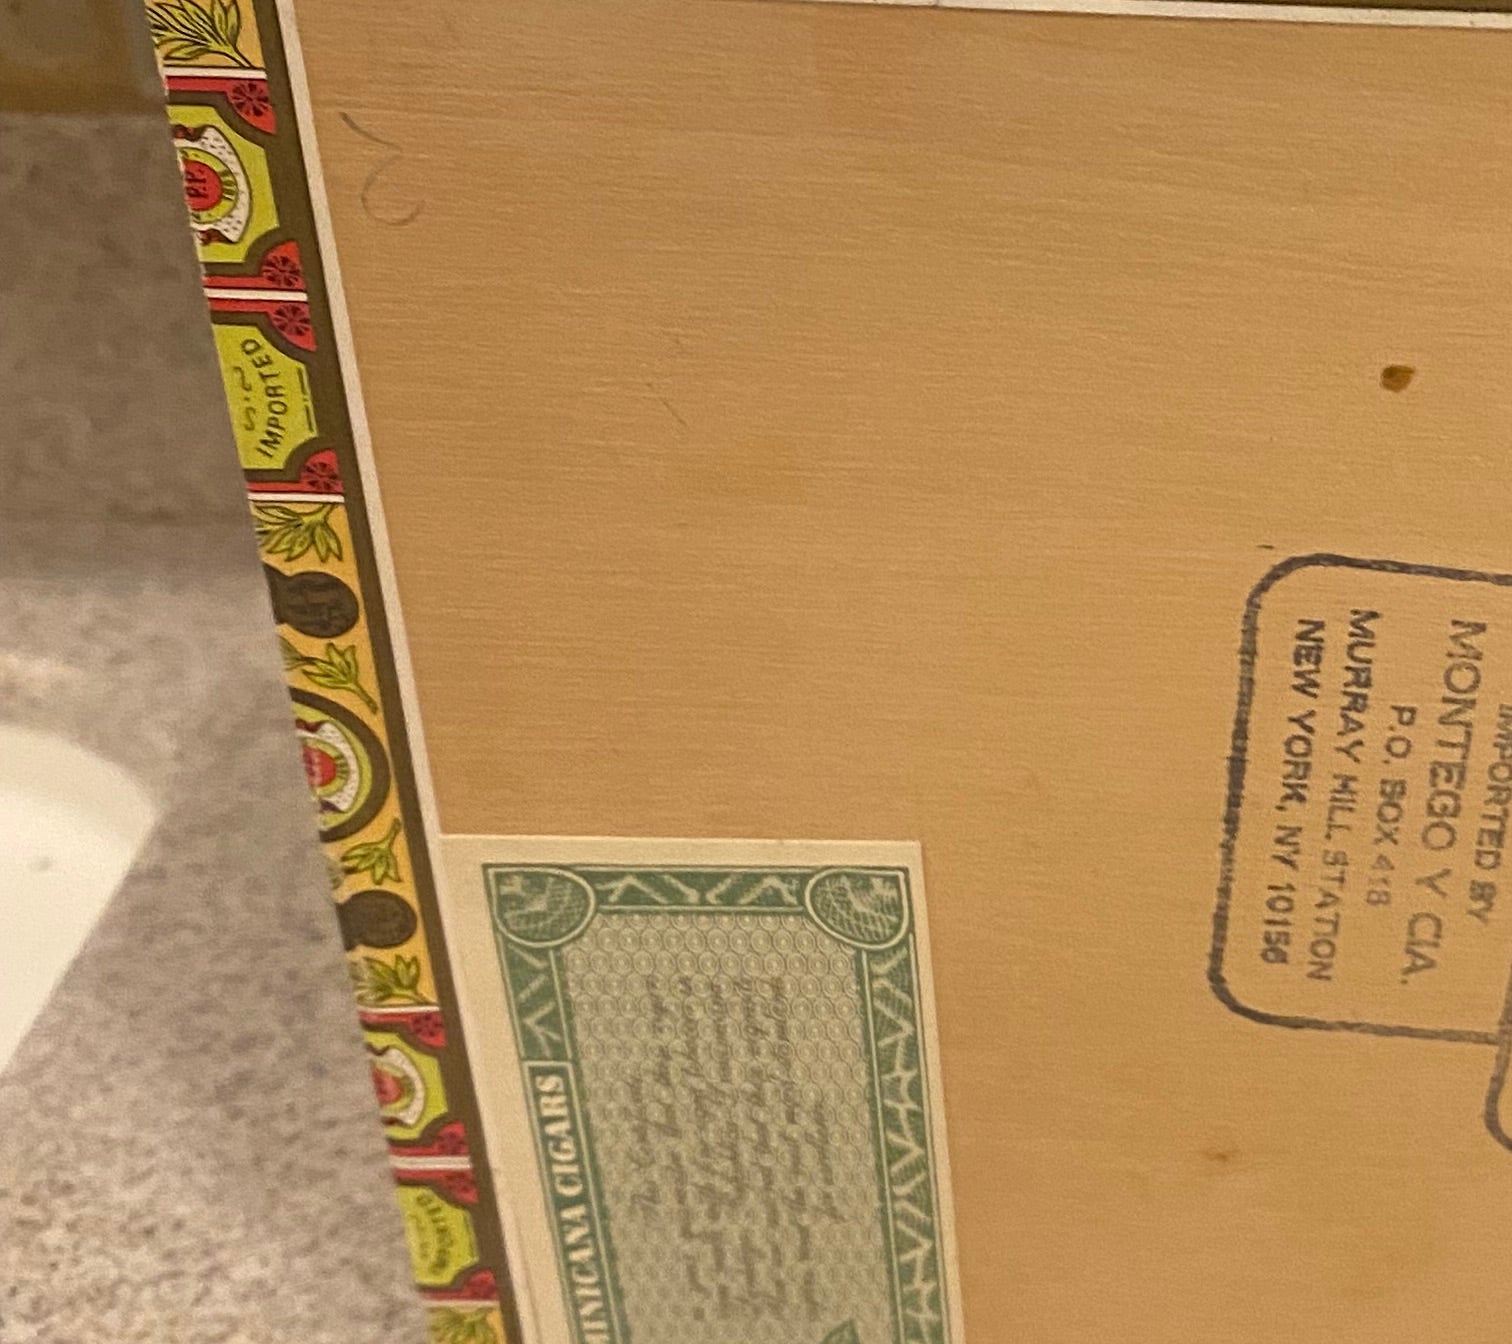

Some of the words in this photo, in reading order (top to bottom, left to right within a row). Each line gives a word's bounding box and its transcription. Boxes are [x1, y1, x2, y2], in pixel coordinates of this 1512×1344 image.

[240, 338, 289, 459] IMPORTED
[1291, 618, 1326, 700] NEW
[1333, 608, 1383, 764] MURRAY
[1274, 709, 1317, 812] YORK,
[1382, 704, 1418, 765] P.O.
[1421, 618, 1488, 851] MONTEGO
[1270, 824, 1303, 871] NY
[1324, 773, 1359, 841] HILL
[1372, 778, 1407, 846] BOX
[1306, 848, 1350, 981] STATION
[1415, 867, 1452, 899] Y
[1399, 912, 1443, 985] CIA.
[533, 1073, 584, 1197] CIGARS
